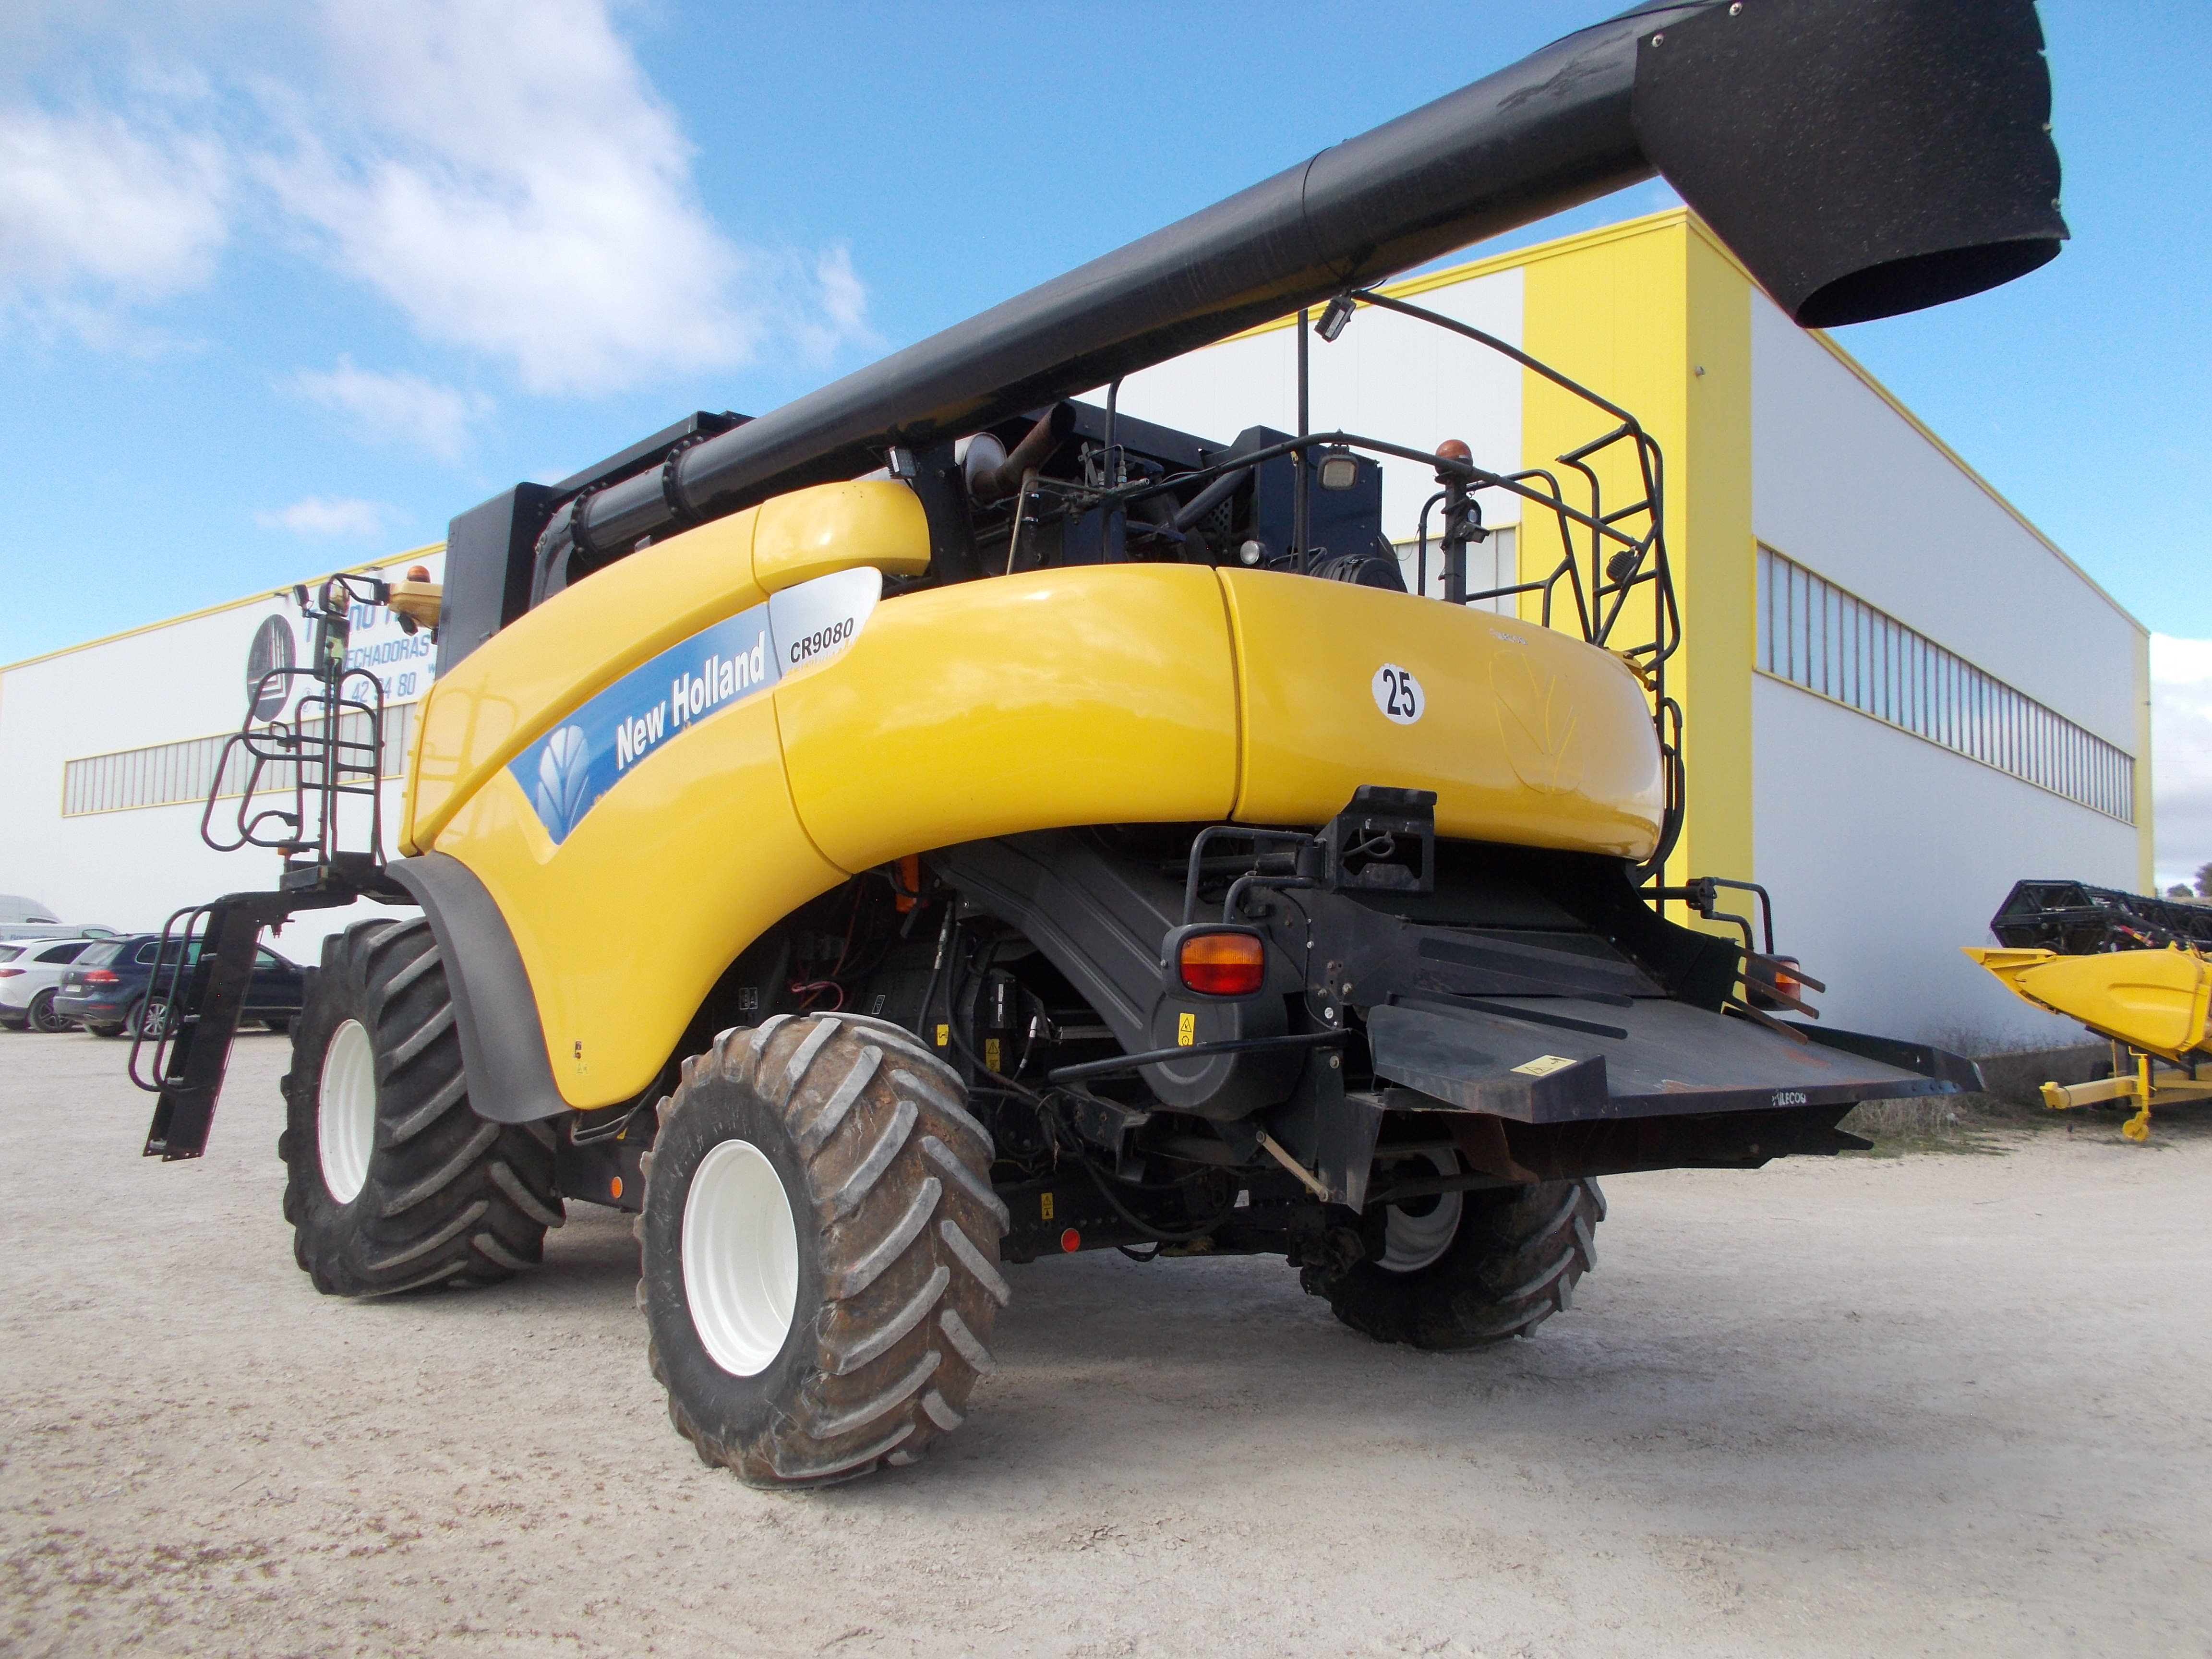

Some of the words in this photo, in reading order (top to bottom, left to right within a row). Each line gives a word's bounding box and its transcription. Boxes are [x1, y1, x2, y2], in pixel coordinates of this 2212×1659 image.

[791, 617, 854, 663] CR9080
[397, 672, 417, 697] 80
[617, 700, 666, 770] New
[672, 630, 765, 727] Holland
[1383, 669, 1415, 718] 25
